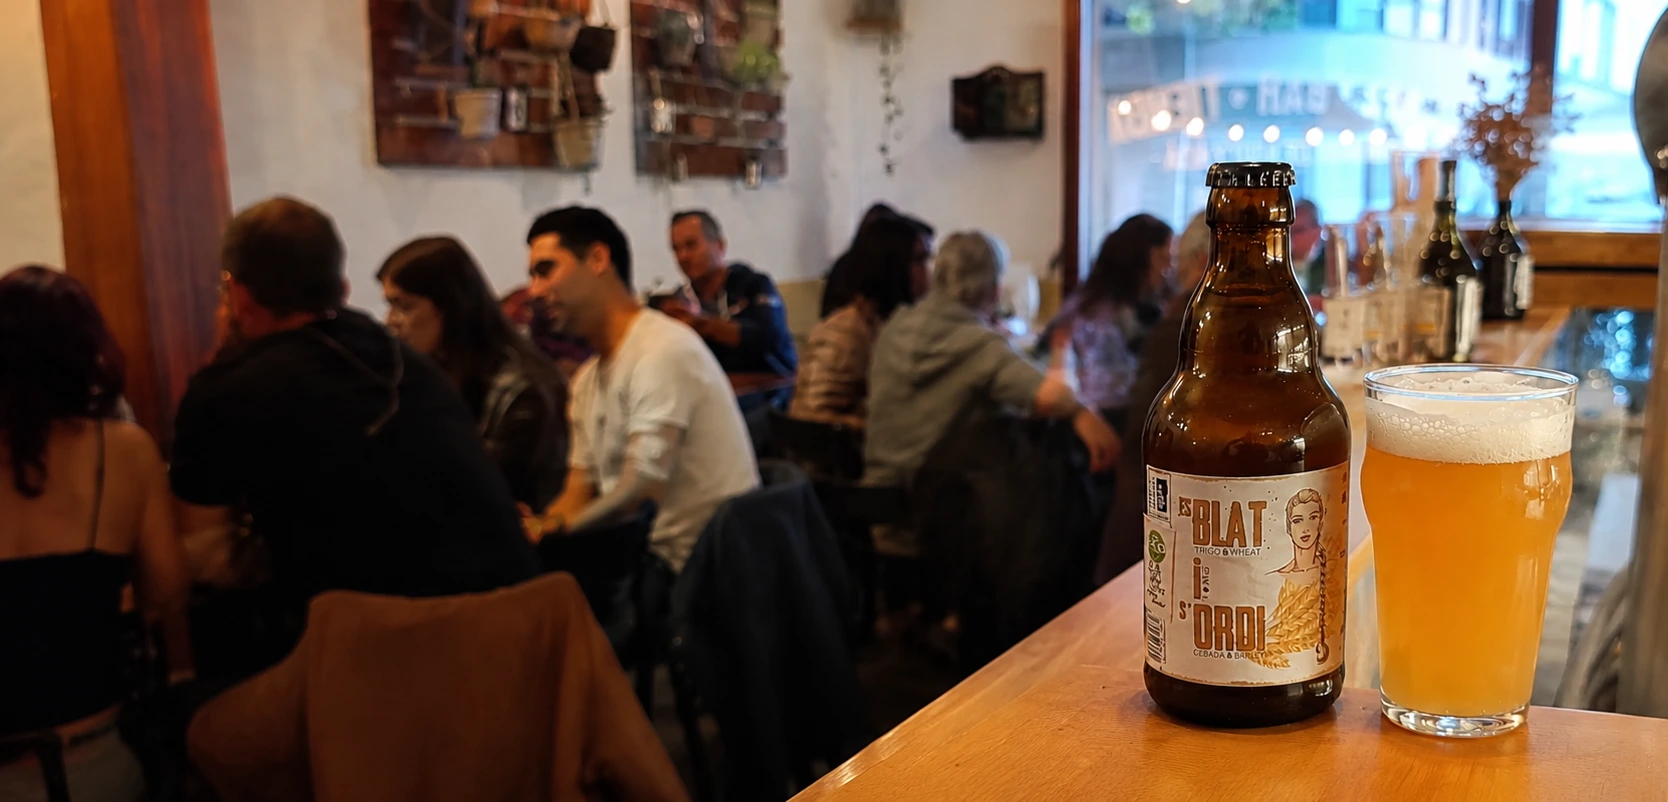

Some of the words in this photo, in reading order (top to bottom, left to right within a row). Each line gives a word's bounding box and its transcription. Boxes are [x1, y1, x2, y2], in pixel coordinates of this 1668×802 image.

[1192, 499, 1267, 547] BLAT
[1194, 547, 1221, 555] TRIGO
[1230, 548, 1261, 556] WHEAT
[1193, 649, 1226, 659] CEBADA
